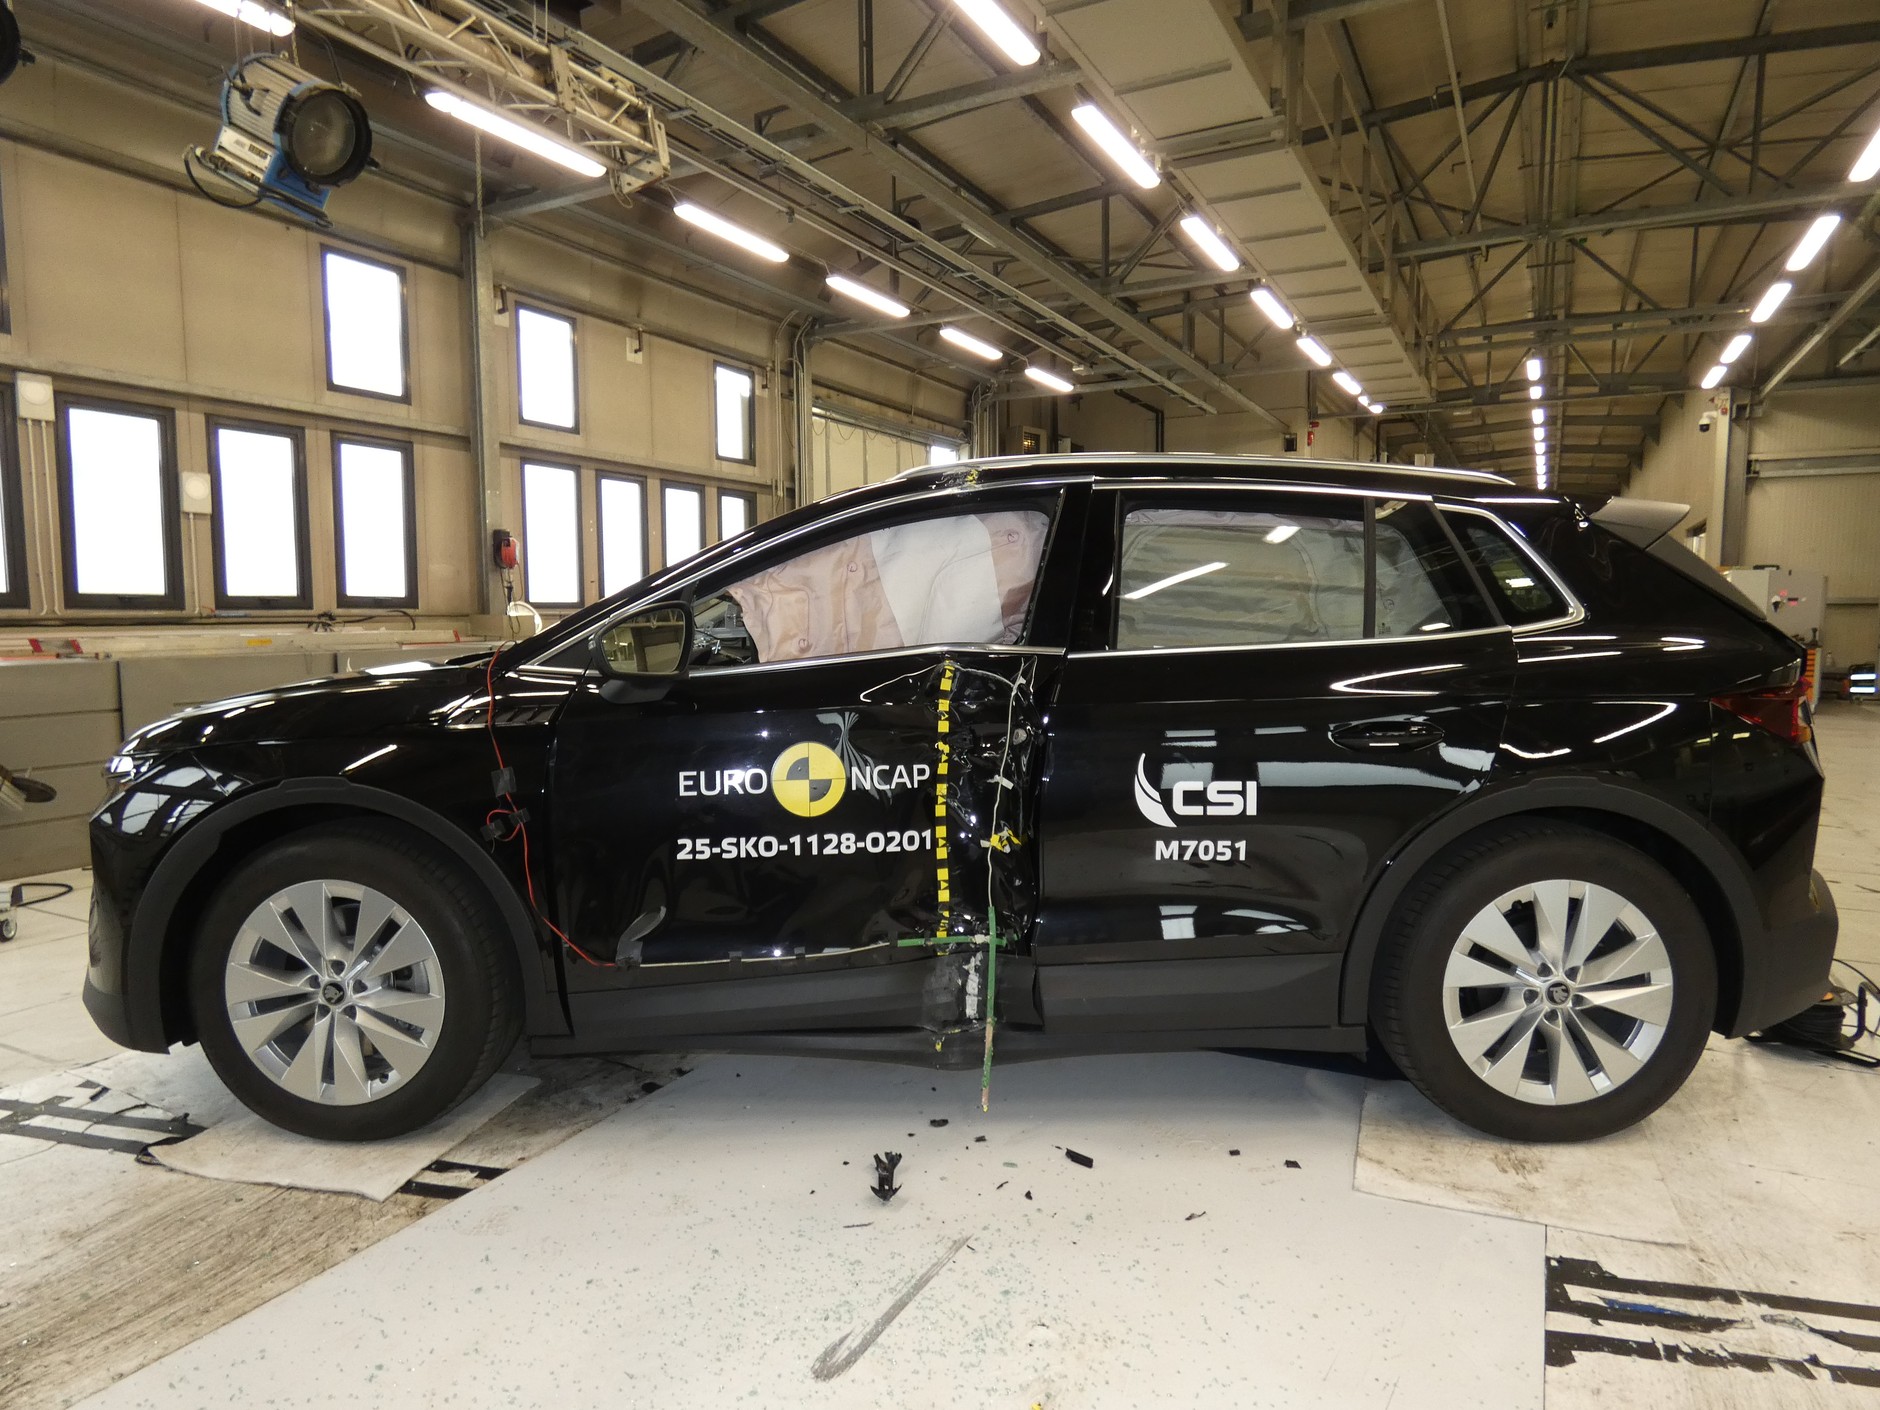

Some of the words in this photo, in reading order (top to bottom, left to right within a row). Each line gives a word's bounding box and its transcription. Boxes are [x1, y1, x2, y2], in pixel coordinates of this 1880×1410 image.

[678, 767, 768, 797] EURO
[851, 763, 930, 791] NCAP
[1172, 781, 1258, 816] CSI
[1155, 839, 1247, 861] M7051
